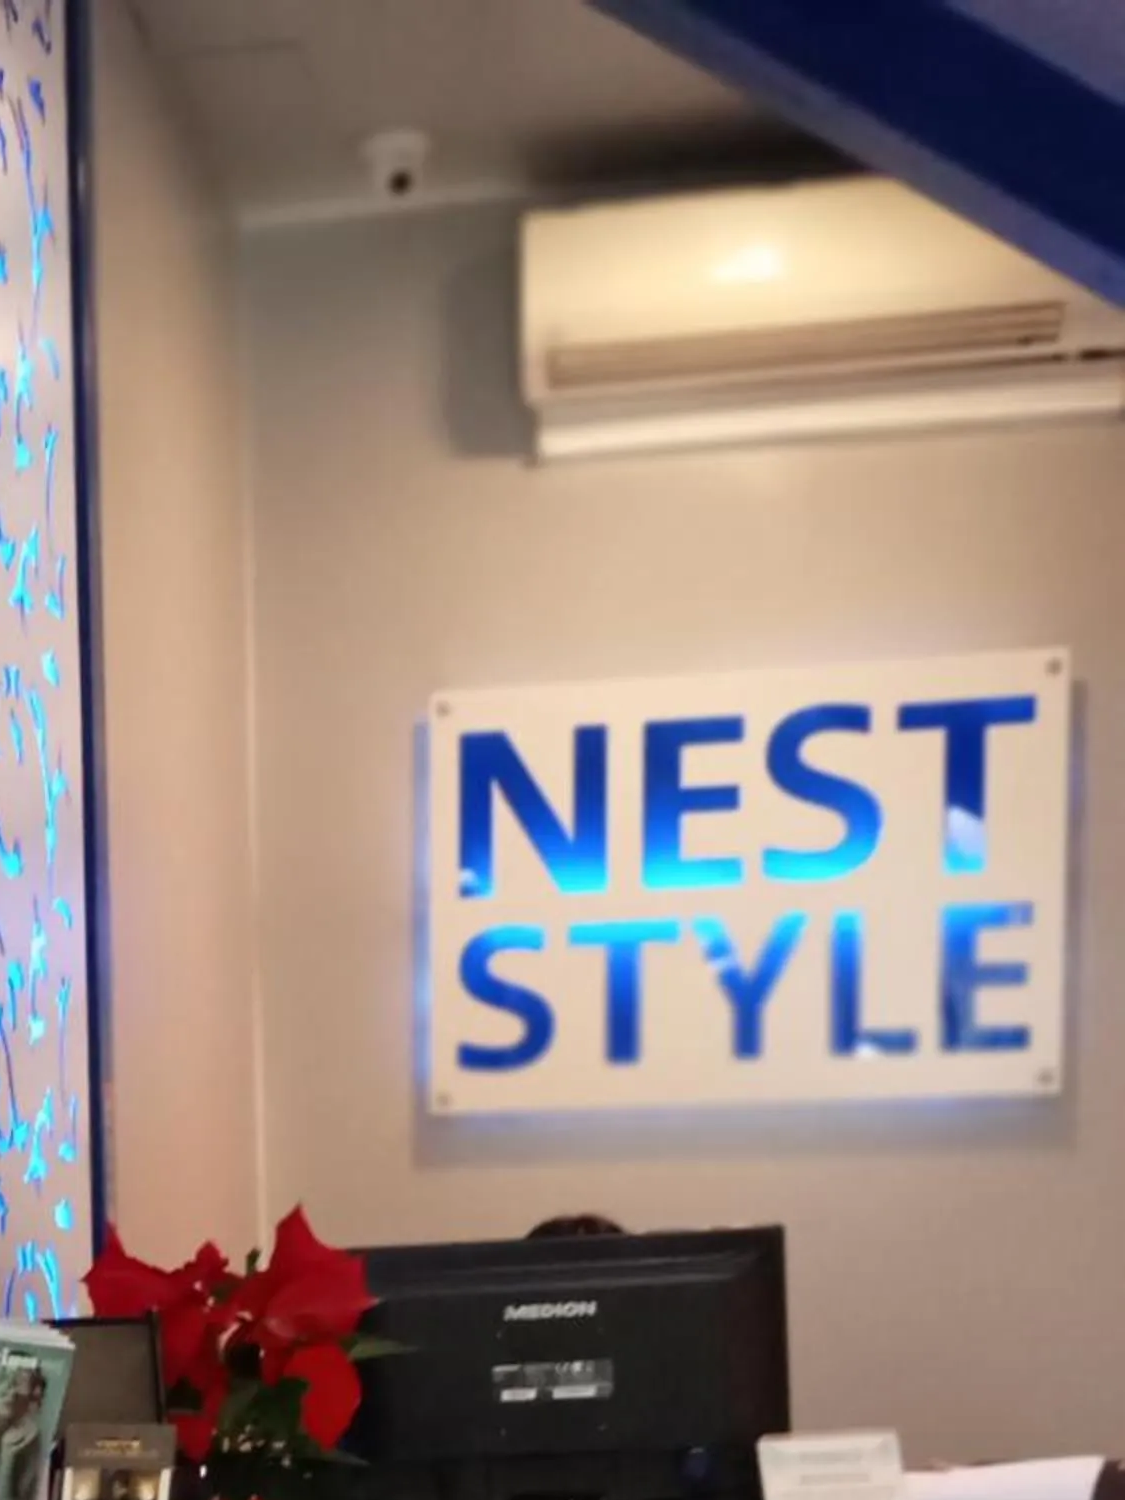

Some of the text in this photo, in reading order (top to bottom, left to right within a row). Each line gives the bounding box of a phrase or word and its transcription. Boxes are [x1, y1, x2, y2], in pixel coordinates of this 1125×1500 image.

[458, 693, 1038, 899] NEST
[456, 901, 1035, 1071] STYLE
[503, 1300, 597, 1321] MEDION
